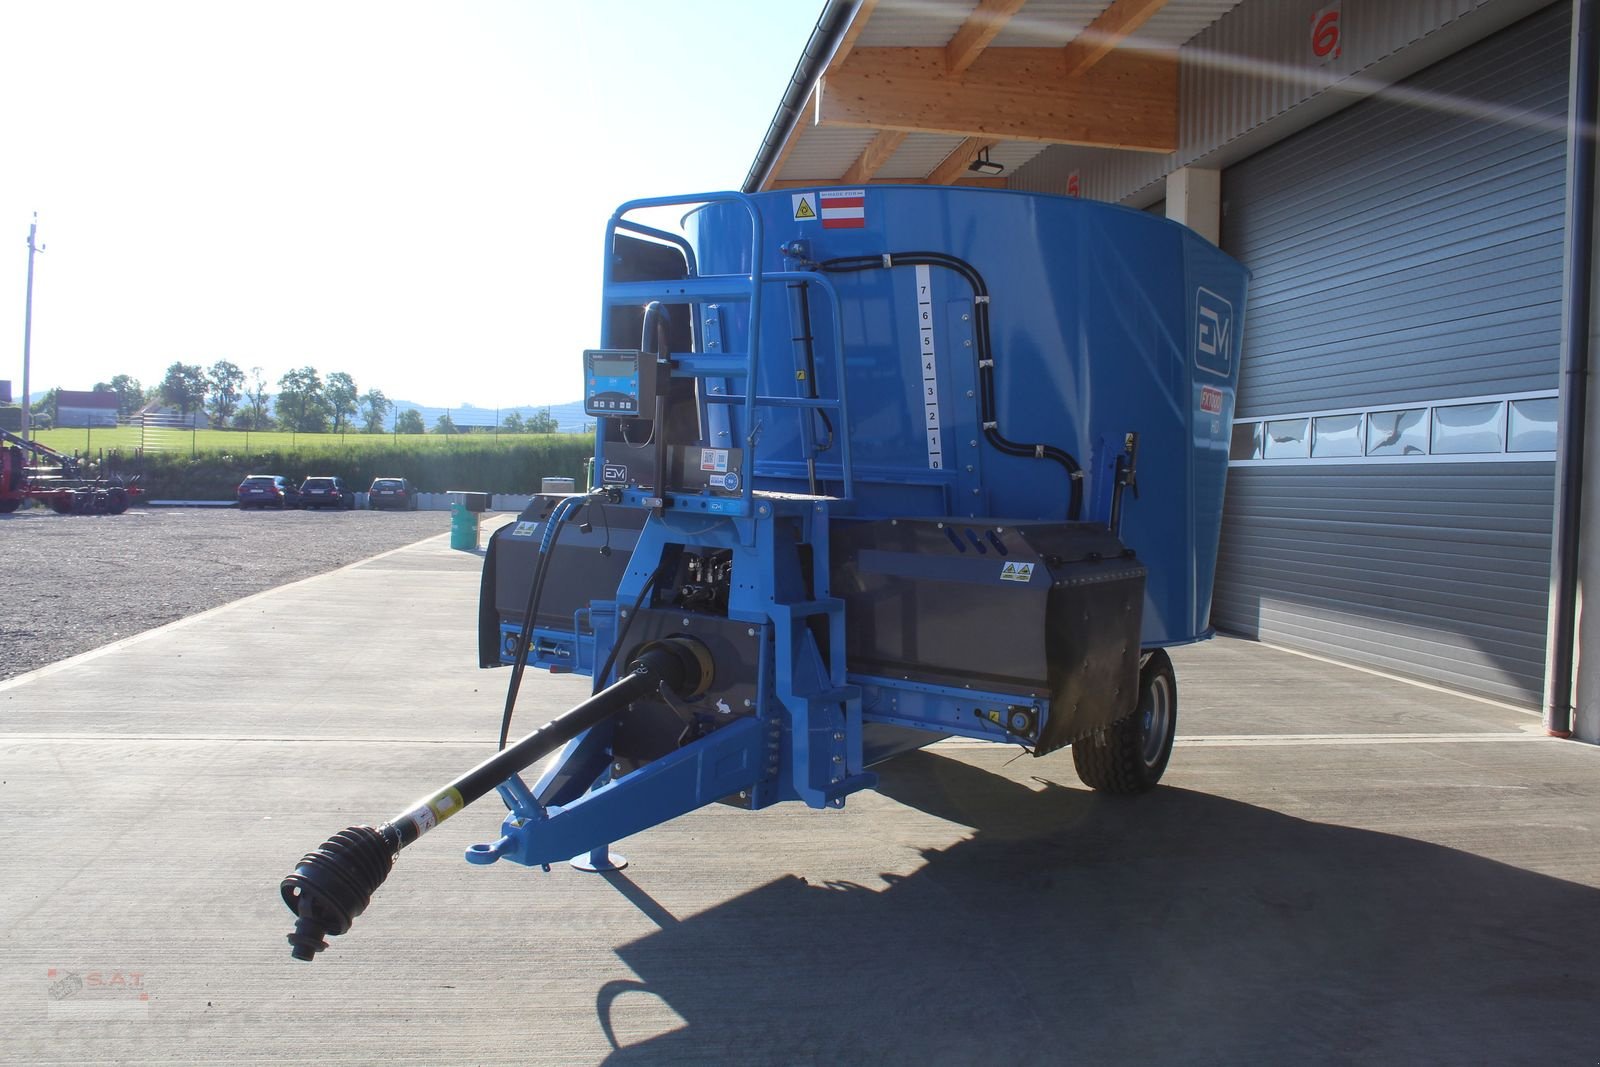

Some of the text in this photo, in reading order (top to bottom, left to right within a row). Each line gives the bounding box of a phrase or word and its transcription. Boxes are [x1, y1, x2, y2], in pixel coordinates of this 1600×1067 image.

[921, 286, 926, 294] 7
[922, 311, 928, 320] 6
[924, 337, 930, 345] 5
[926, 362, 931, 370] 4
[928, 387, 934, 396] 3
[929, 412, 935, 420] 2
[932, 437, 936, 445] 1
